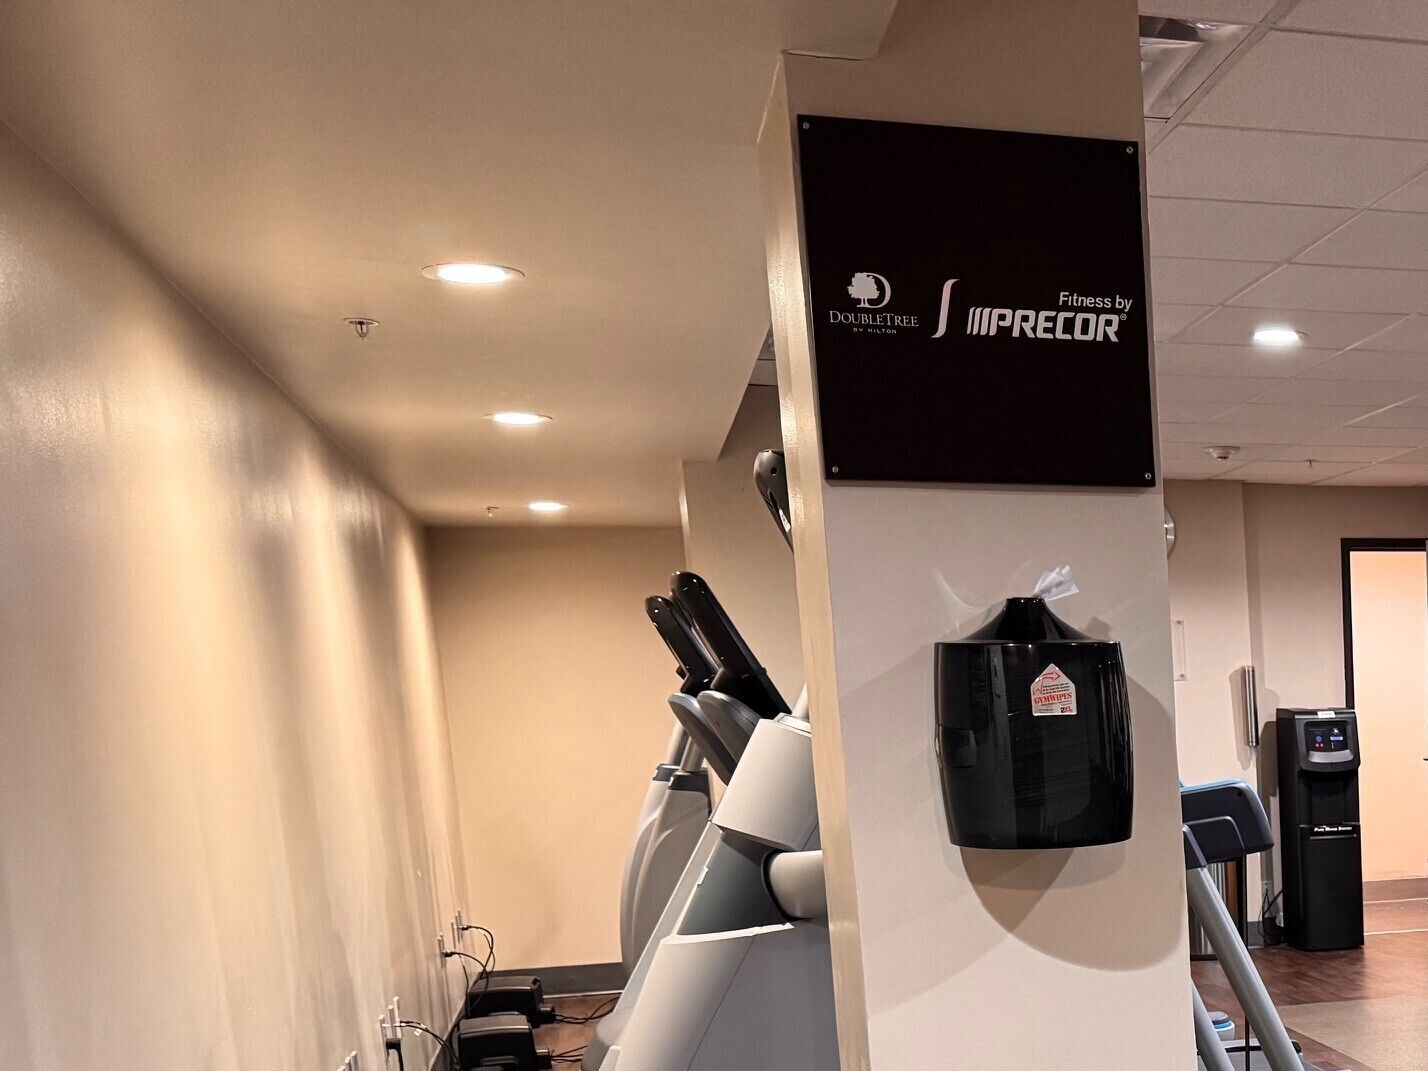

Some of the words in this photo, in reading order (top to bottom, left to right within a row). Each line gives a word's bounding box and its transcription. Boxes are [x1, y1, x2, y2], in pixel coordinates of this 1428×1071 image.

[1058, 291, 1112, 308] Fitness
[1115, 295, 1133, 312] by
[1034, 692, 1072, 704] GYMWIPES
